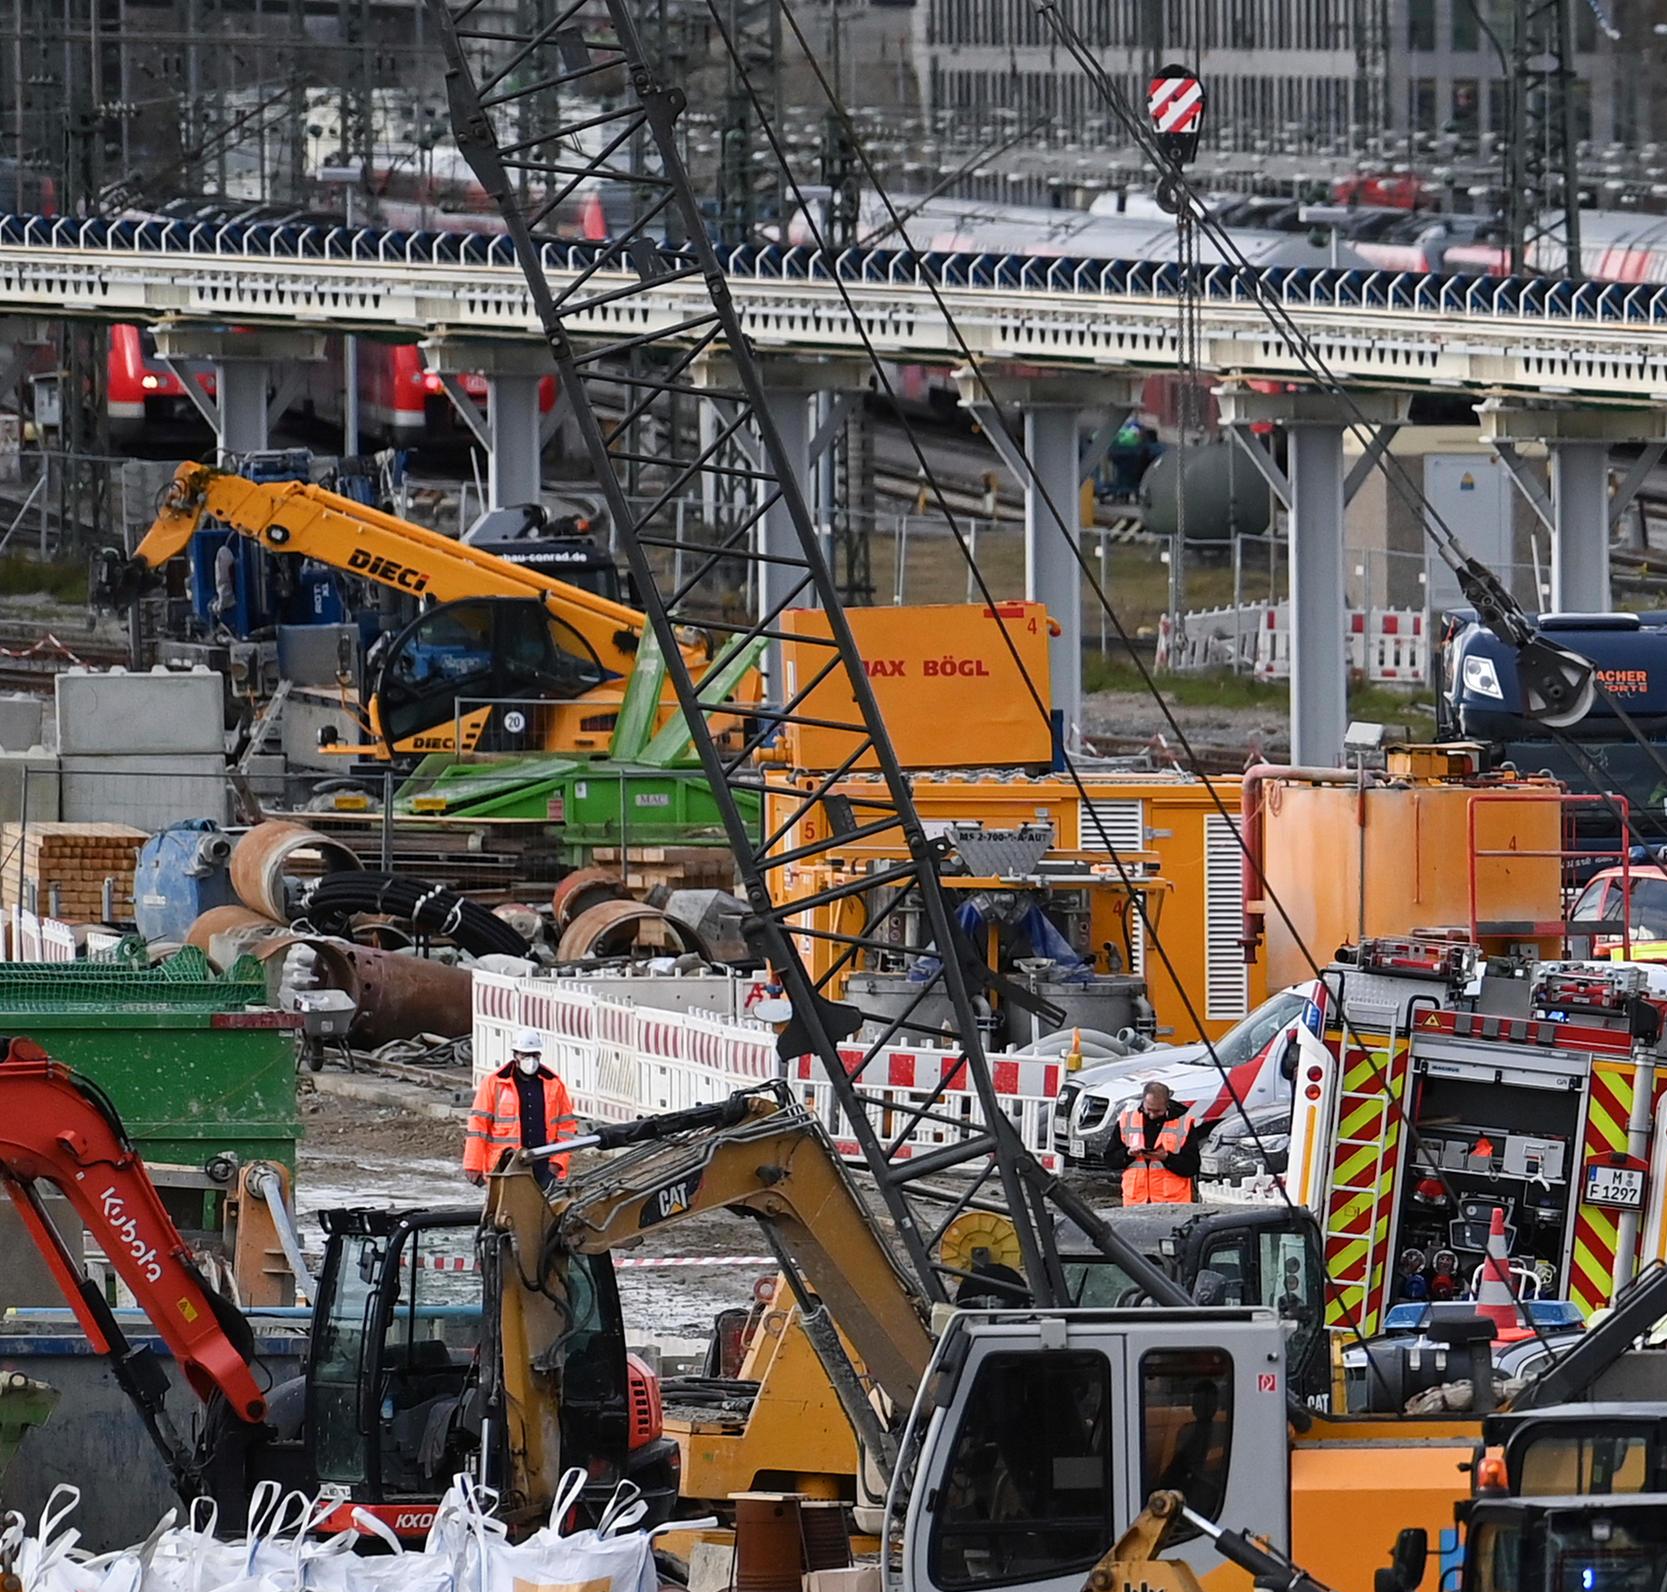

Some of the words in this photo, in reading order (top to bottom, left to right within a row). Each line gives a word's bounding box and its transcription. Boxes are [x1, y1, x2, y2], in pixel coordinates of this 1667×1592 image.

[1026, 617, 1038, 635] 4
[923, 655, 990, 677] BÖGL
[508, 715, 523, 729] 20
[804, 821, 816, 840] 5
[1508, 835, 1516, 852] 4
[1612, 1170, 1623, 1184] M
[658, 1183, 689, 1218] CAT
[1590, 1185, 1600, 1198] F
[1602, 1186, 1638, 1202] 1297
[99, 1187, 162, 1283] Kubota
[1307, 1392, 1330, 1414] CAT
